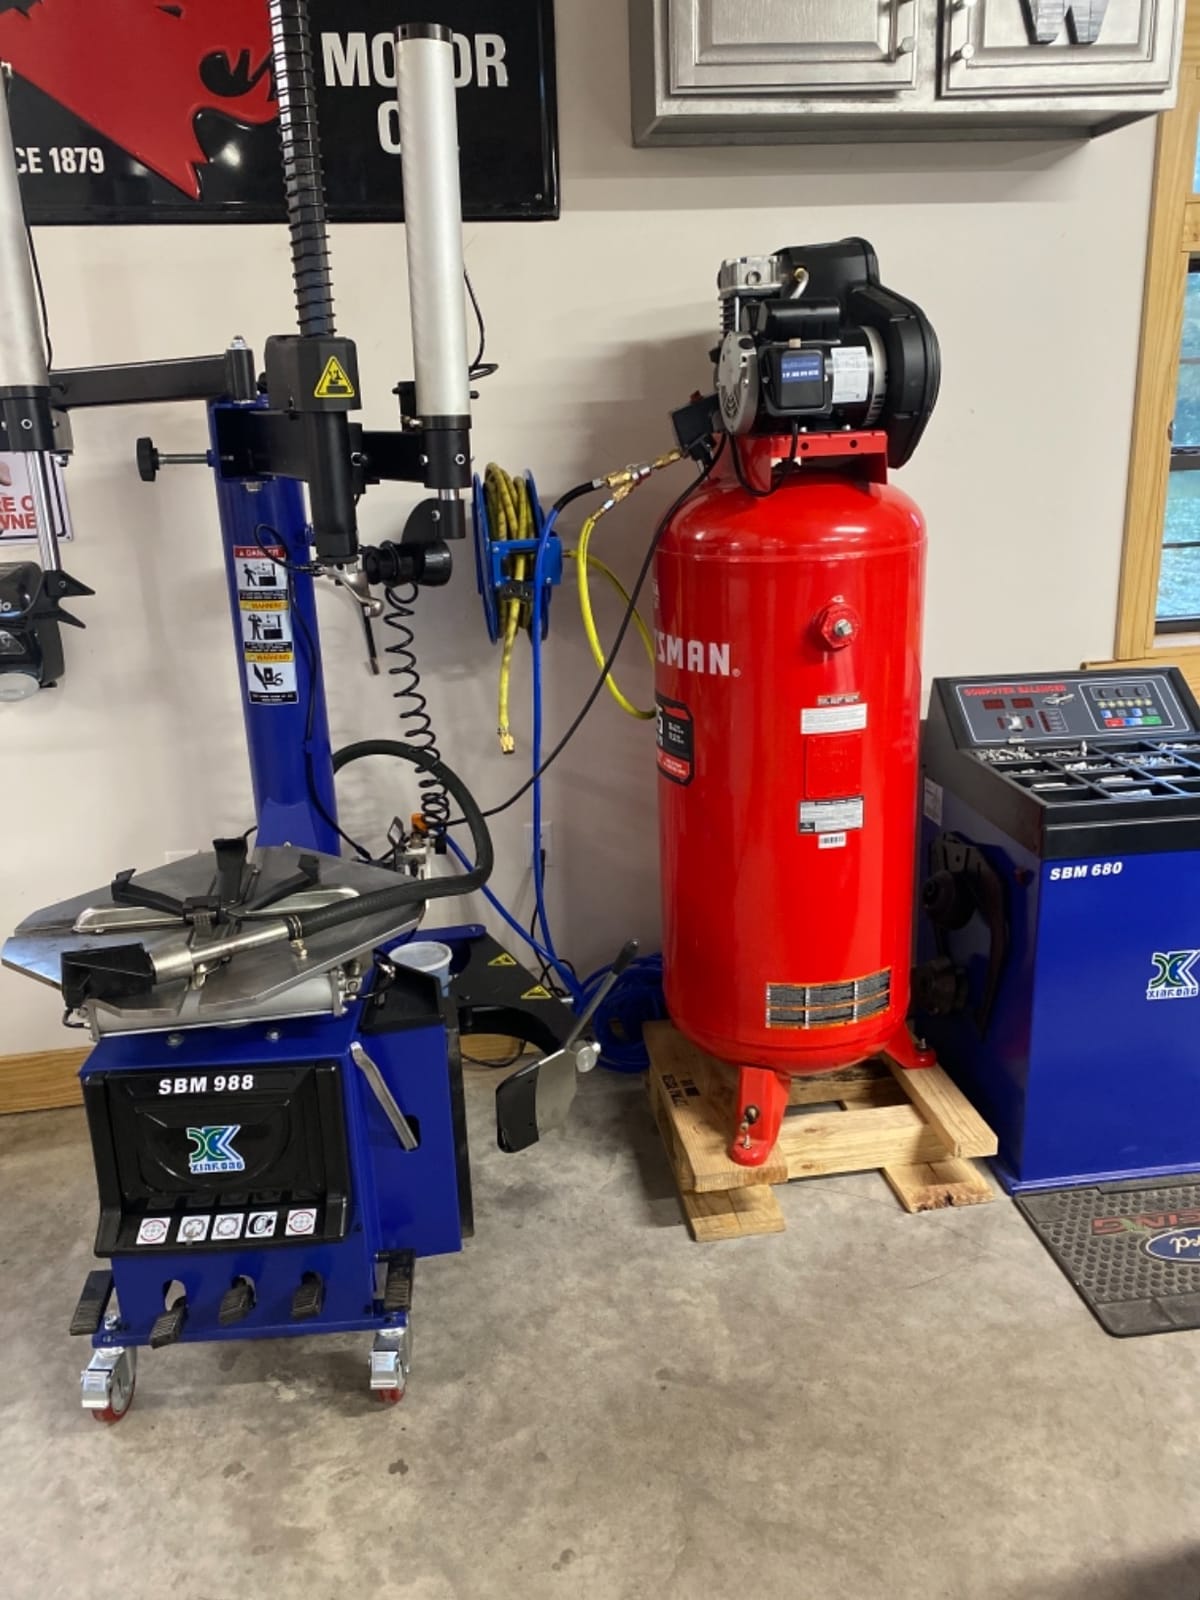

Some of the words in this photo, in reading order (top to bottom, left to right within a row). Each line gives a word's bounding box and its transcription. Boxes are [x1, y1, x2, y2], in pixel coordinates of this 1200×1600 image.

[321, 32, 509, 88] MOOR
[49, 147, 105, 174] 1879
[656, 630, 730, 676] SMAN
[1049, 865, 1088, 881] SBM
[1091, 862, 1123, 876] 680
[158, 1076, 206, 1095] SBM
[213, 1074, 254, 1091] 988
